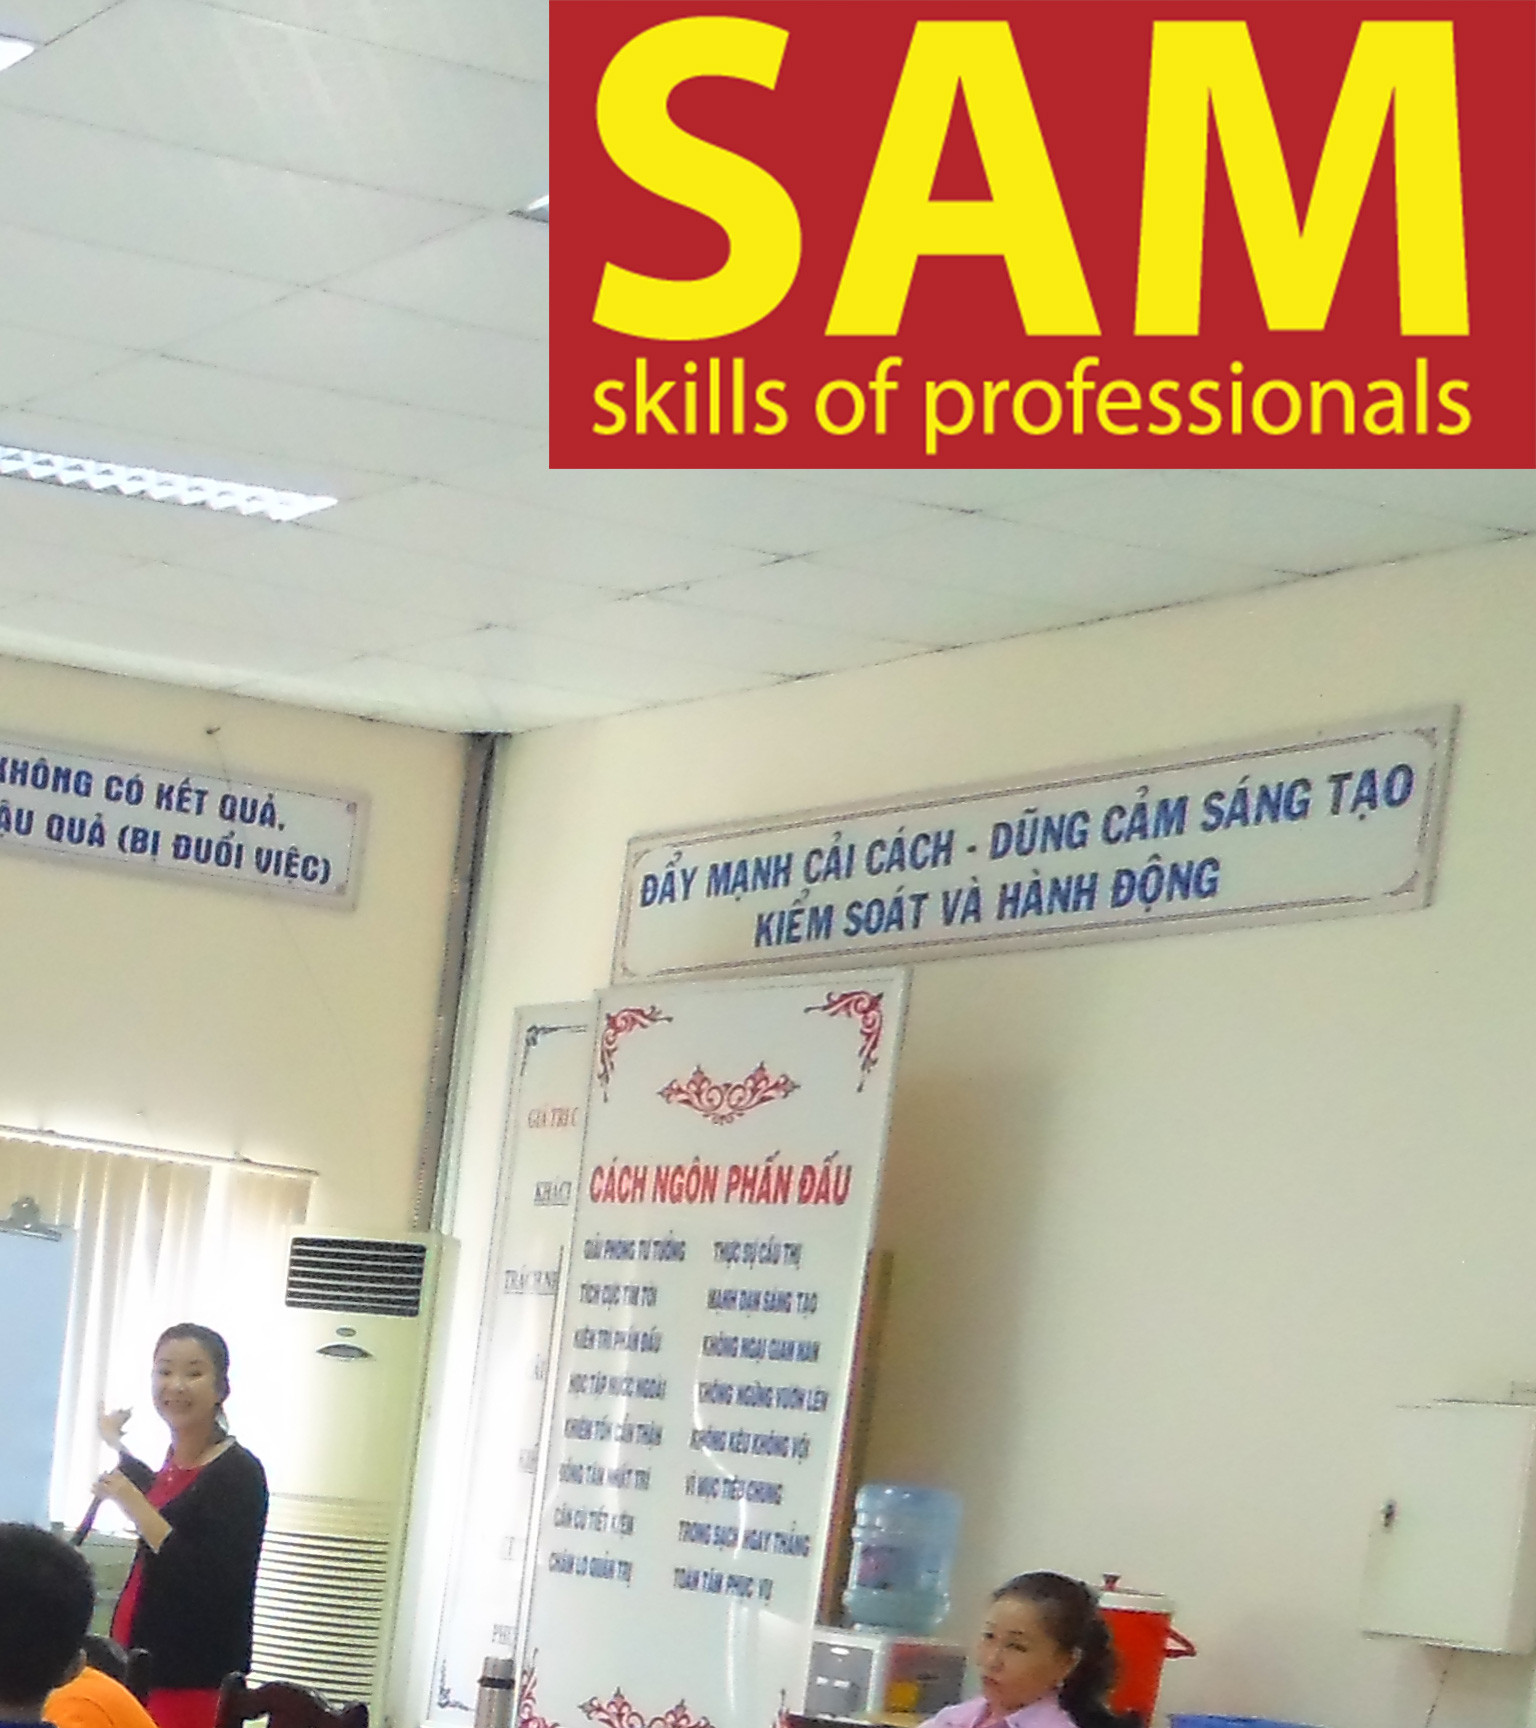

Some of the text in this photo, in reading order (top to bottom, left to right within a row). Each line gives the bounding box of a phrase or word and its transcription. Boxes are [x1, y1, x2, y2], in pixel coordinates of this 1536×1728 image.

[104, 771, 145, 806] CÓ
[156, 775, 210, 817] KẾT
[640, 850, 697, 907] ĐẨY
[706, 854, 792, 901] MẠNH
[802, 834, 854, 886] CẢI
[865, 820, 953, 879] CÁCH
[988, 805, 1089, 860] DŨNG
[1101, 785, 1186, 844] CẢM
[1199, 771, 1313, 832] SÁNG
[1329, 762, 1414, 822] TẠO
[753, 854, 1222, 949] KIỂM SOÁT VÀ HÀNH ĐỘNG
[588, 1150, 852, 1206] CÁCH NGÔN PHẤN ĐẤU
